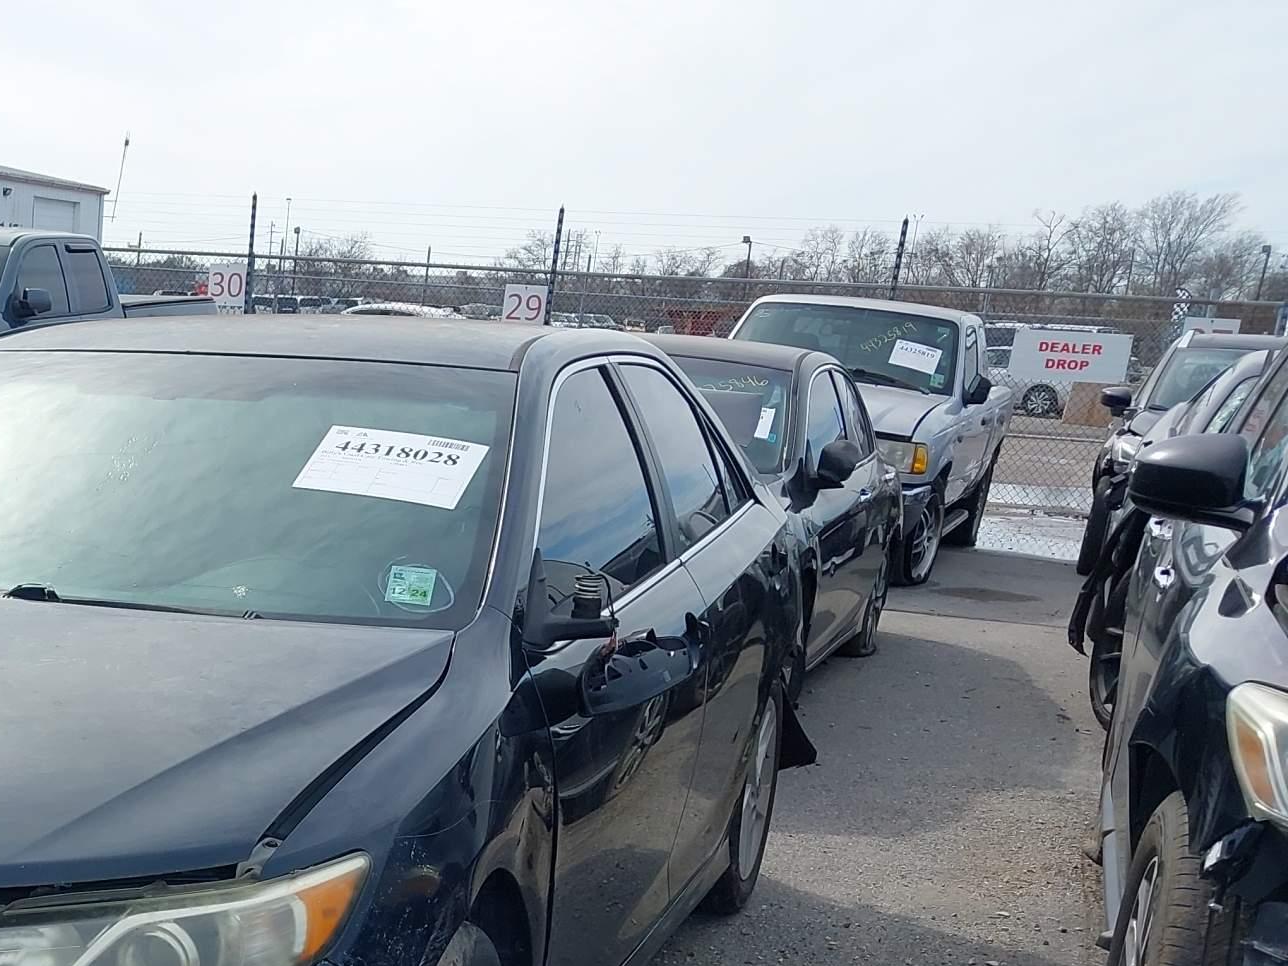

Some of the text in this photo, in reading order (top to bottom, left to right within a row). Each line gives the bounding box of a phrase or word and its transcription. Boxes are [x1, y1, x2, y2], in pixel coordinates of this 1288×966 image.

[210, 271, 243, 298] 30
[505, 293, 543, 321] 29
[859, 321, 918, 353] 44325819
[1038, 341, 1103, 356] DEALER
[1044, 358, 1090, 371] DROP
[335, 440, 461, 467] 44318028
